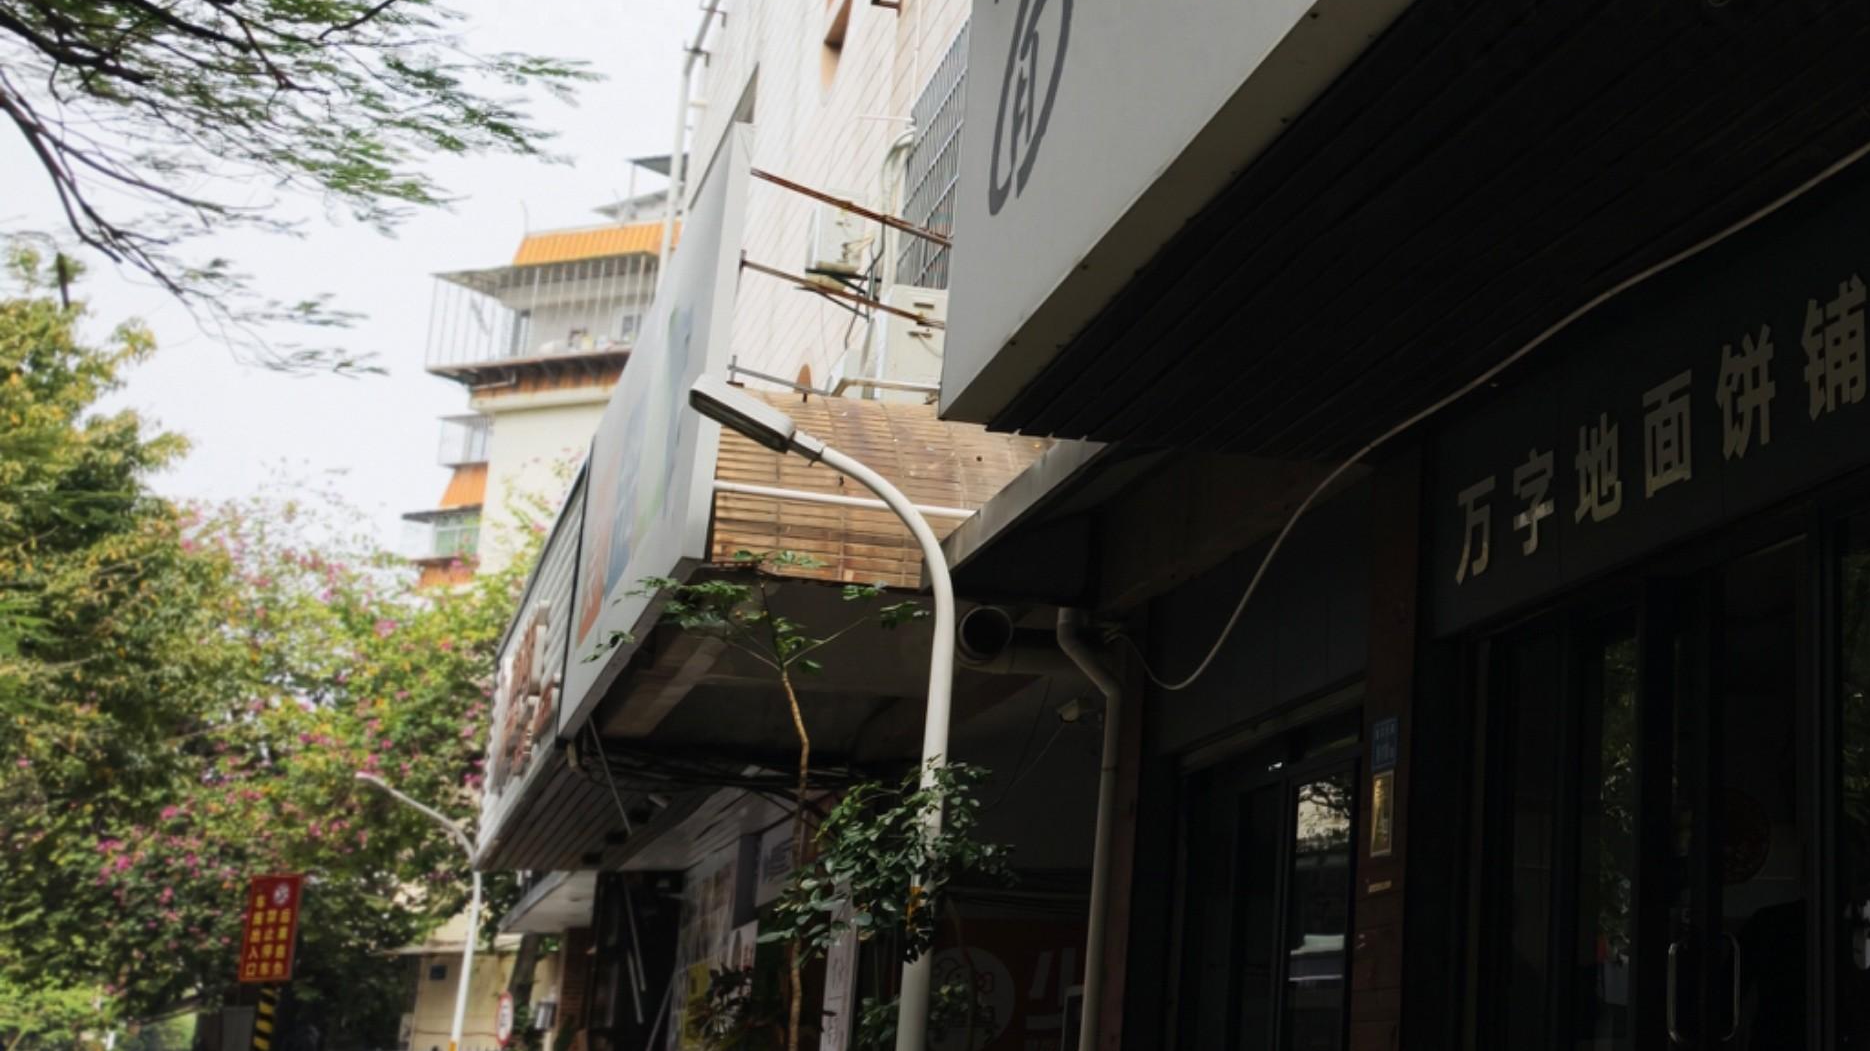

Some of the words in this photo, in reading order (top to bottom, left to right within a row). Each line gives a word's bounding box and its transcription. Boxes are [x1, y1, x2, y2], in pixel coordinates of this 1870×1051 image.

[1455, 273, 1868, 587] 万字地面饼铺
